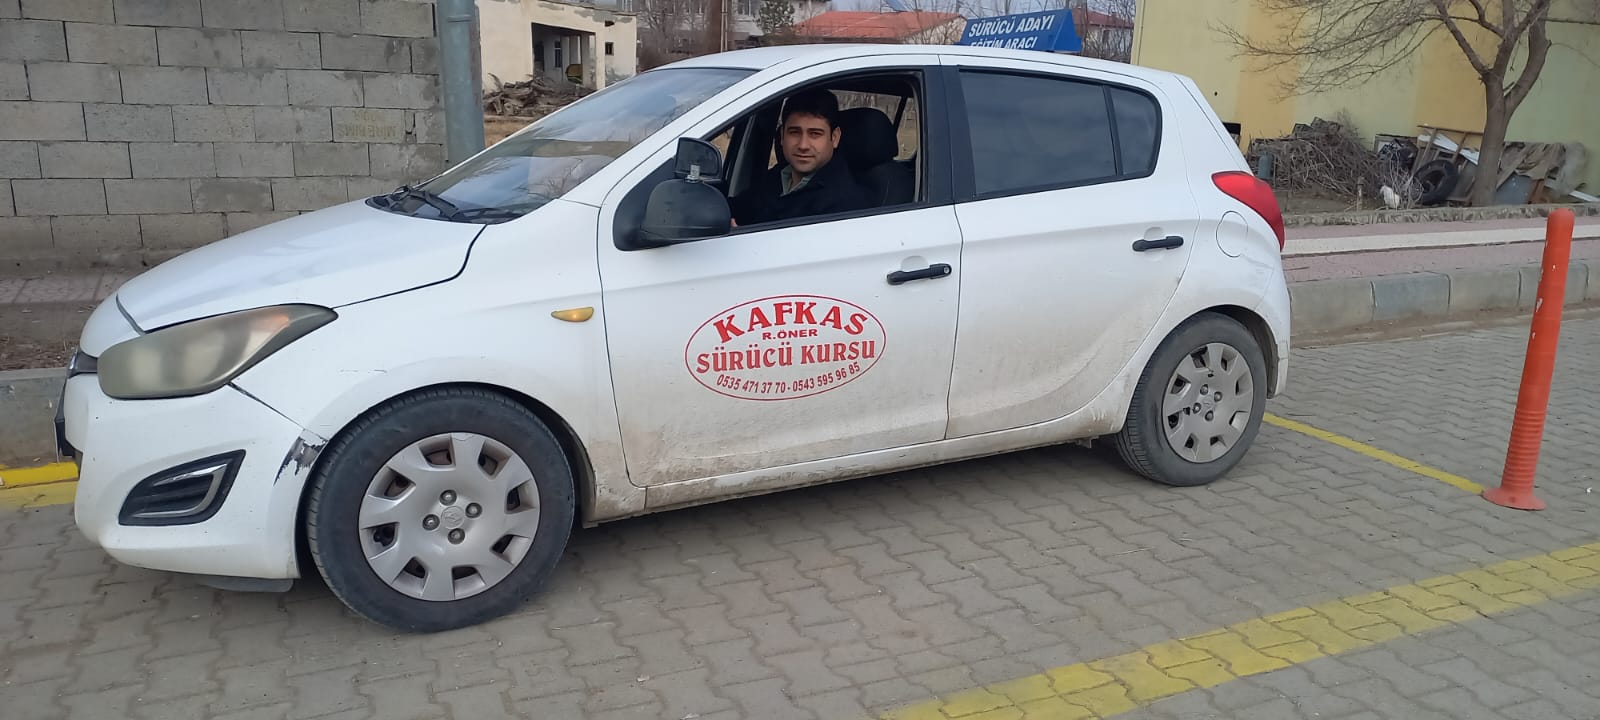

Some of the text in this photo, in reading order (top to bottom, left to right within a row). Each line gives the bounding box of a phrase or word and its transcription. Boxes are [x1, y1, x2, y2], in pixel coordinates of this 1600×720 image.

[969, 15, 1055, 37] SÜRÜCÜ ADAYI
[1004, 36, 1038, 49] ARACI
[713, 301, 868, 343] KAFKAS
[762, 328, 818, 340] R.ÖNER
[696, 340, 875, 374] SÜRÜCÜ KURSU
[716, 374, 740, 390] 0535
[742, 379, 759, 393] 471
[760, 381, 772, 394] 37
[775, 381, 786, 393] 70
[792, 378, 815, 392] 0543
[817, 373, 834, 387] 595
[835, 368, 847, 381] 96
[848, 361, 860, 375] 85
